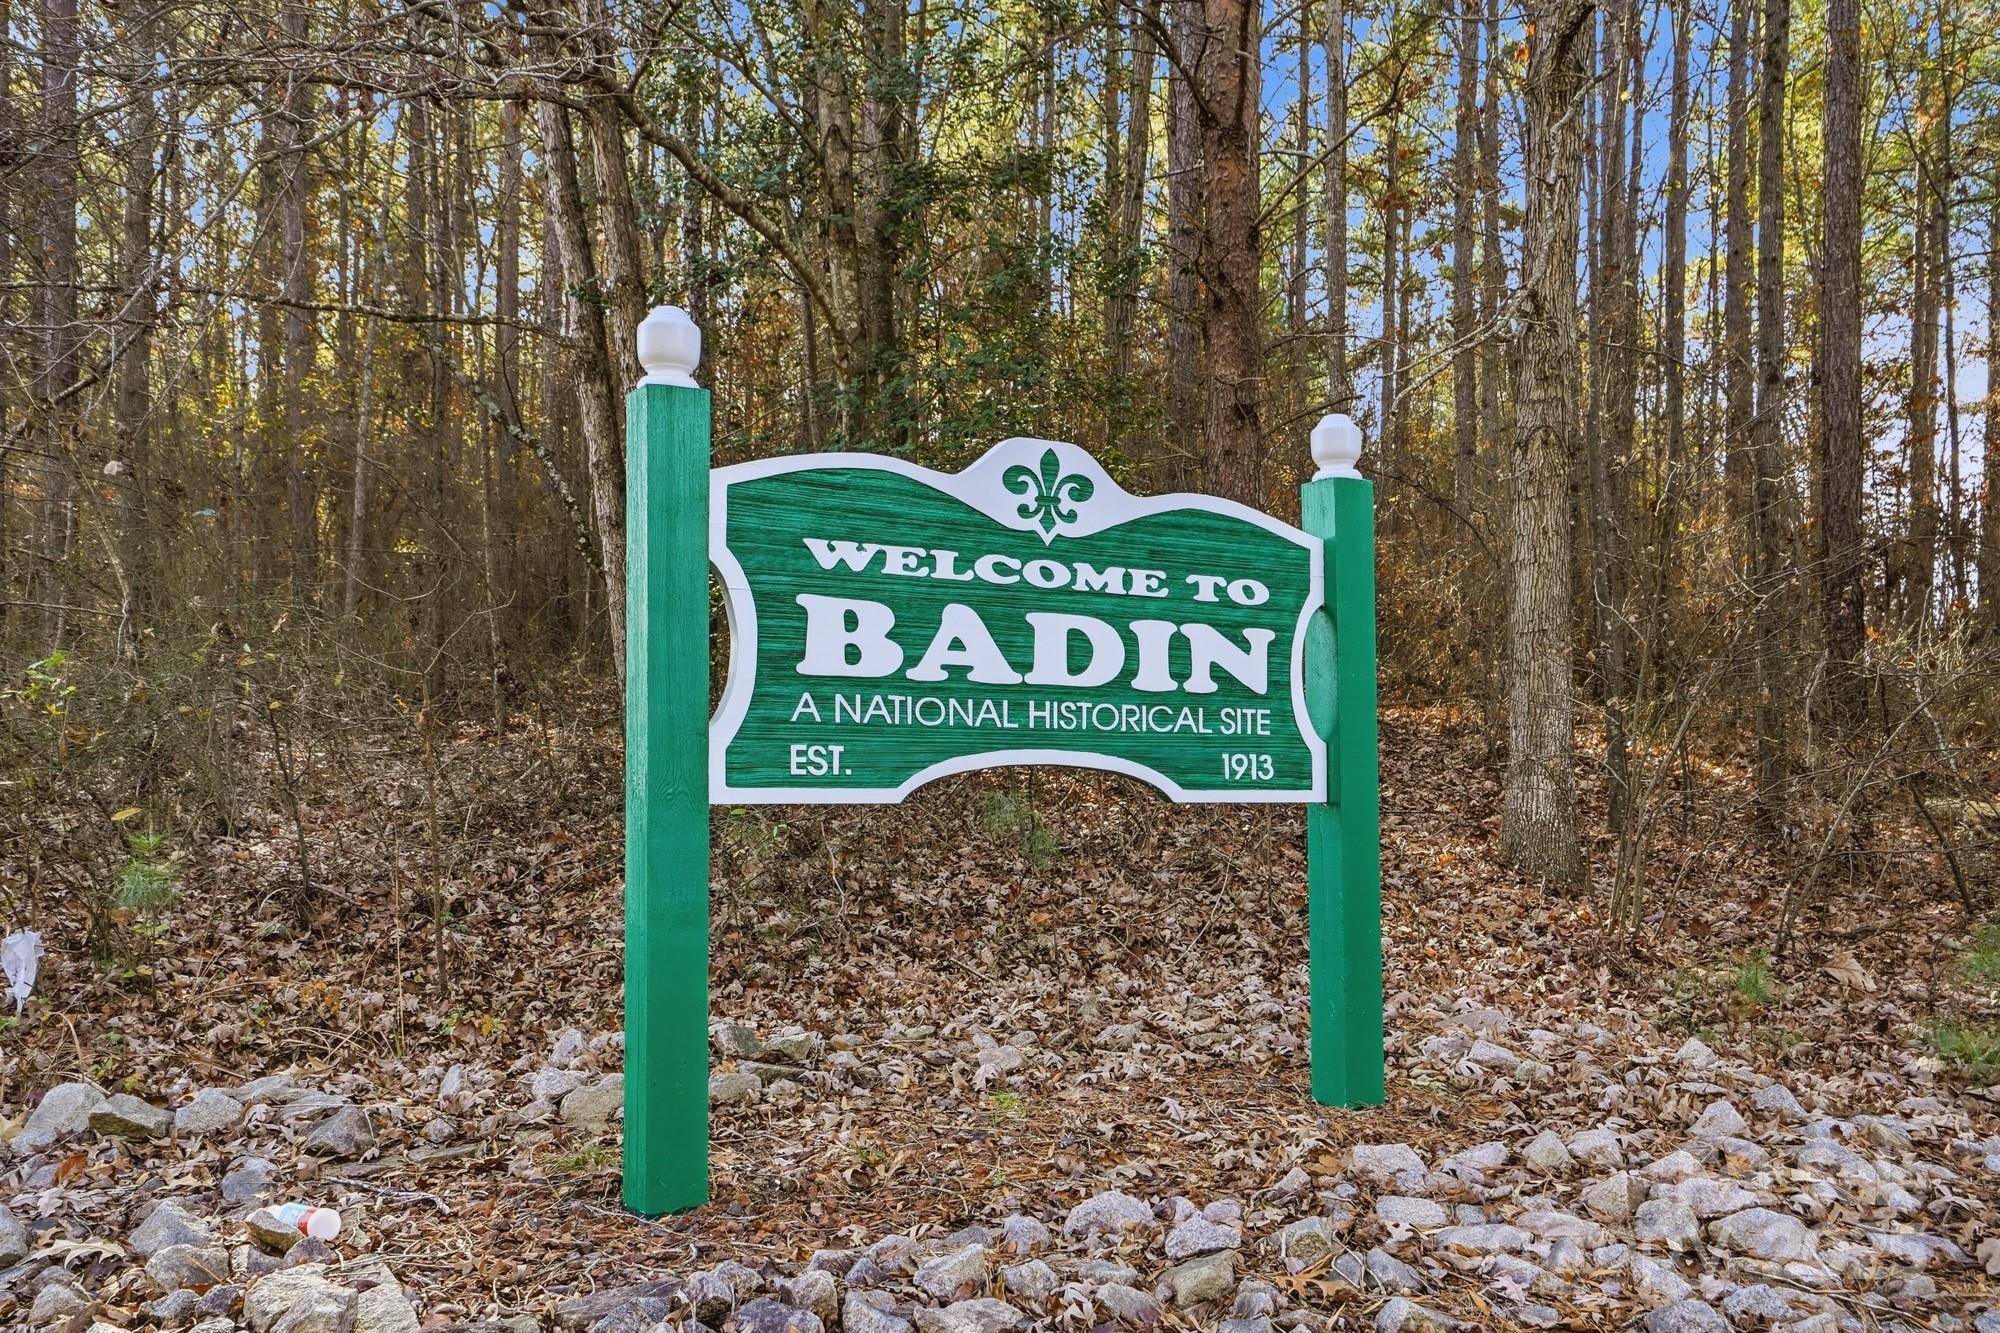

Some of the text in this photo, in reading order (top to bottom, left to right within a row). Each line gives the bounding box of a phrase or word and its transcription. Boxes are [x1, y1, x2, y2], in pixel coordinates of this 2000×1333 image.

[803, 537, 1270, 606] WELCOME TO
[796, 593, 1276, 695] BADIN
[791, 692, 1271, 735] A NATIONAL HISTORICAL SITE
[790, 744, 1274, 780] EST. 1913
